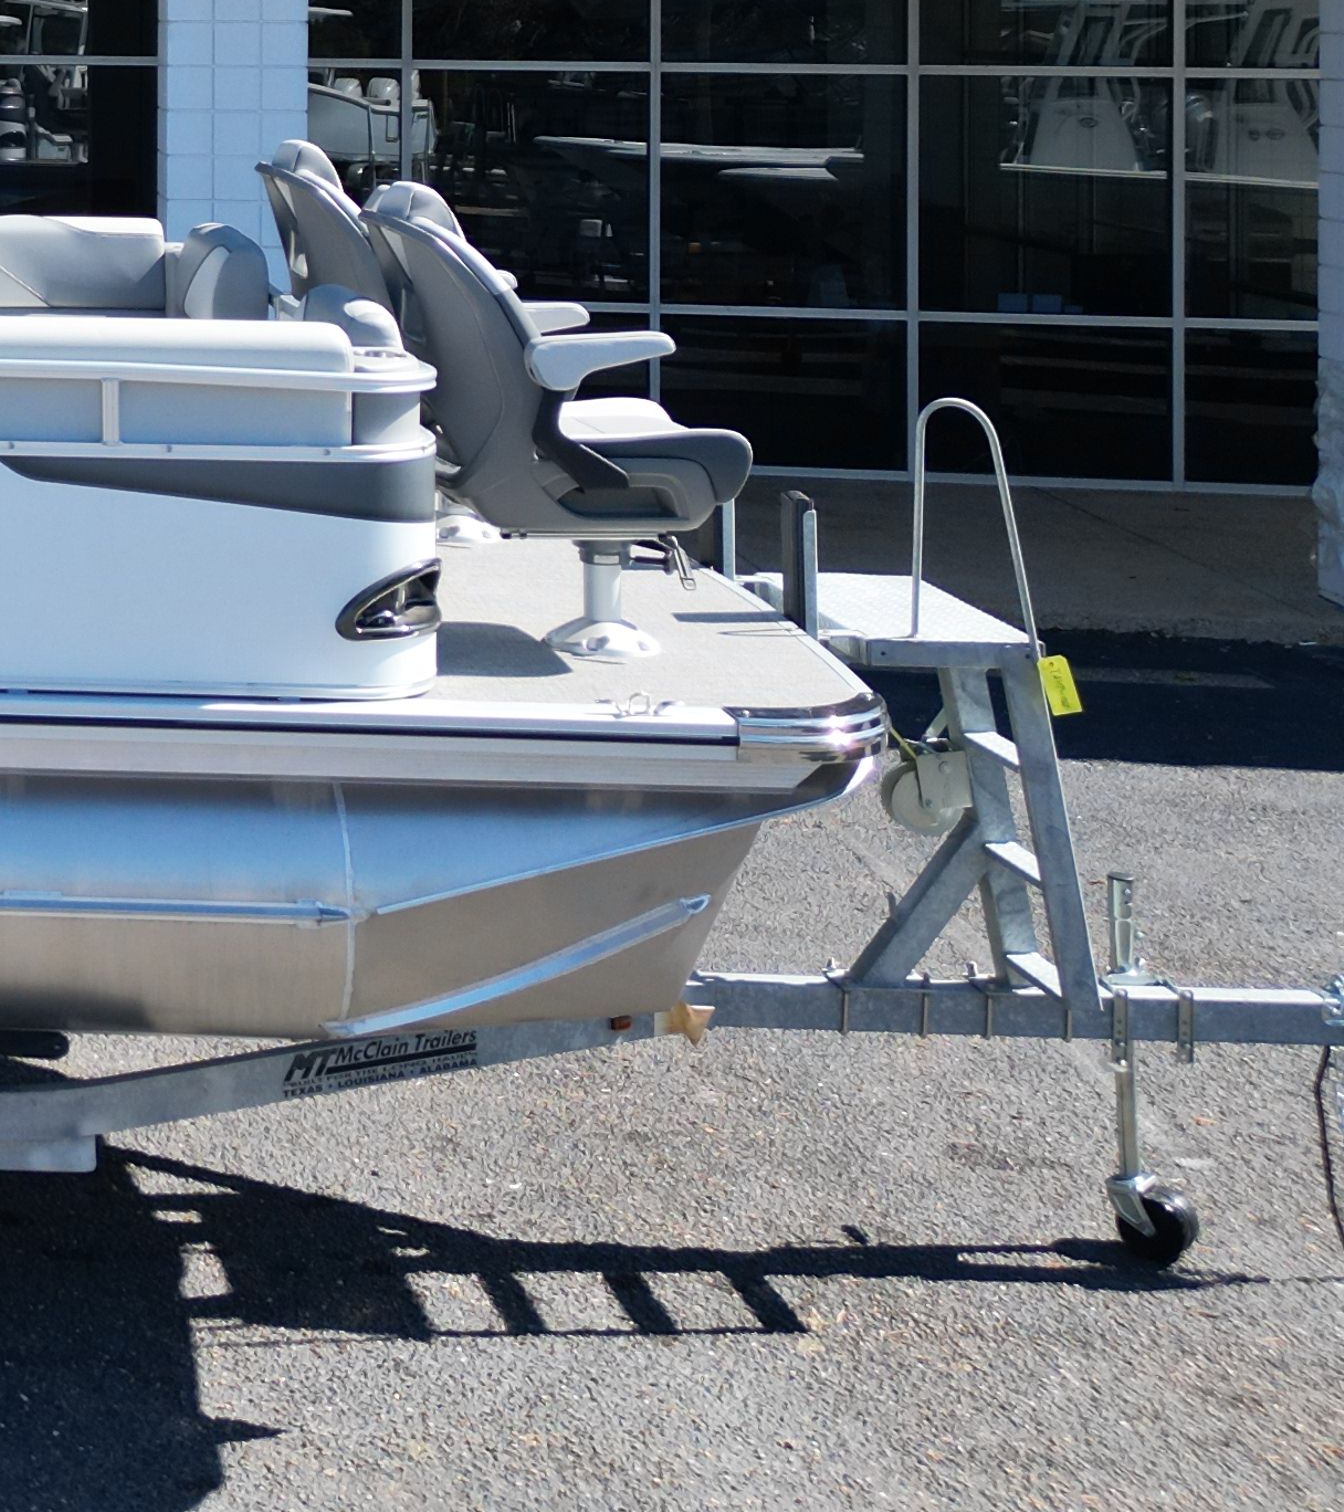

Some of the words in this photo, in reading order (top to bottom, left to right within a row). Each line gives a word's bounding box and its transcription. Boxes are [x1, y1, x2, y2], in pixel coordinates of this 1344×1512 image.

[335, 1037, 410, 1065] McClain
[414, 1029, 478, 1051] Trailers
[283, 1083, 323, 1098] TEXAS
[338, 1070, 405, 1087] LOUISIANA
[419, 1057, 478, 1075] ALABAMA
